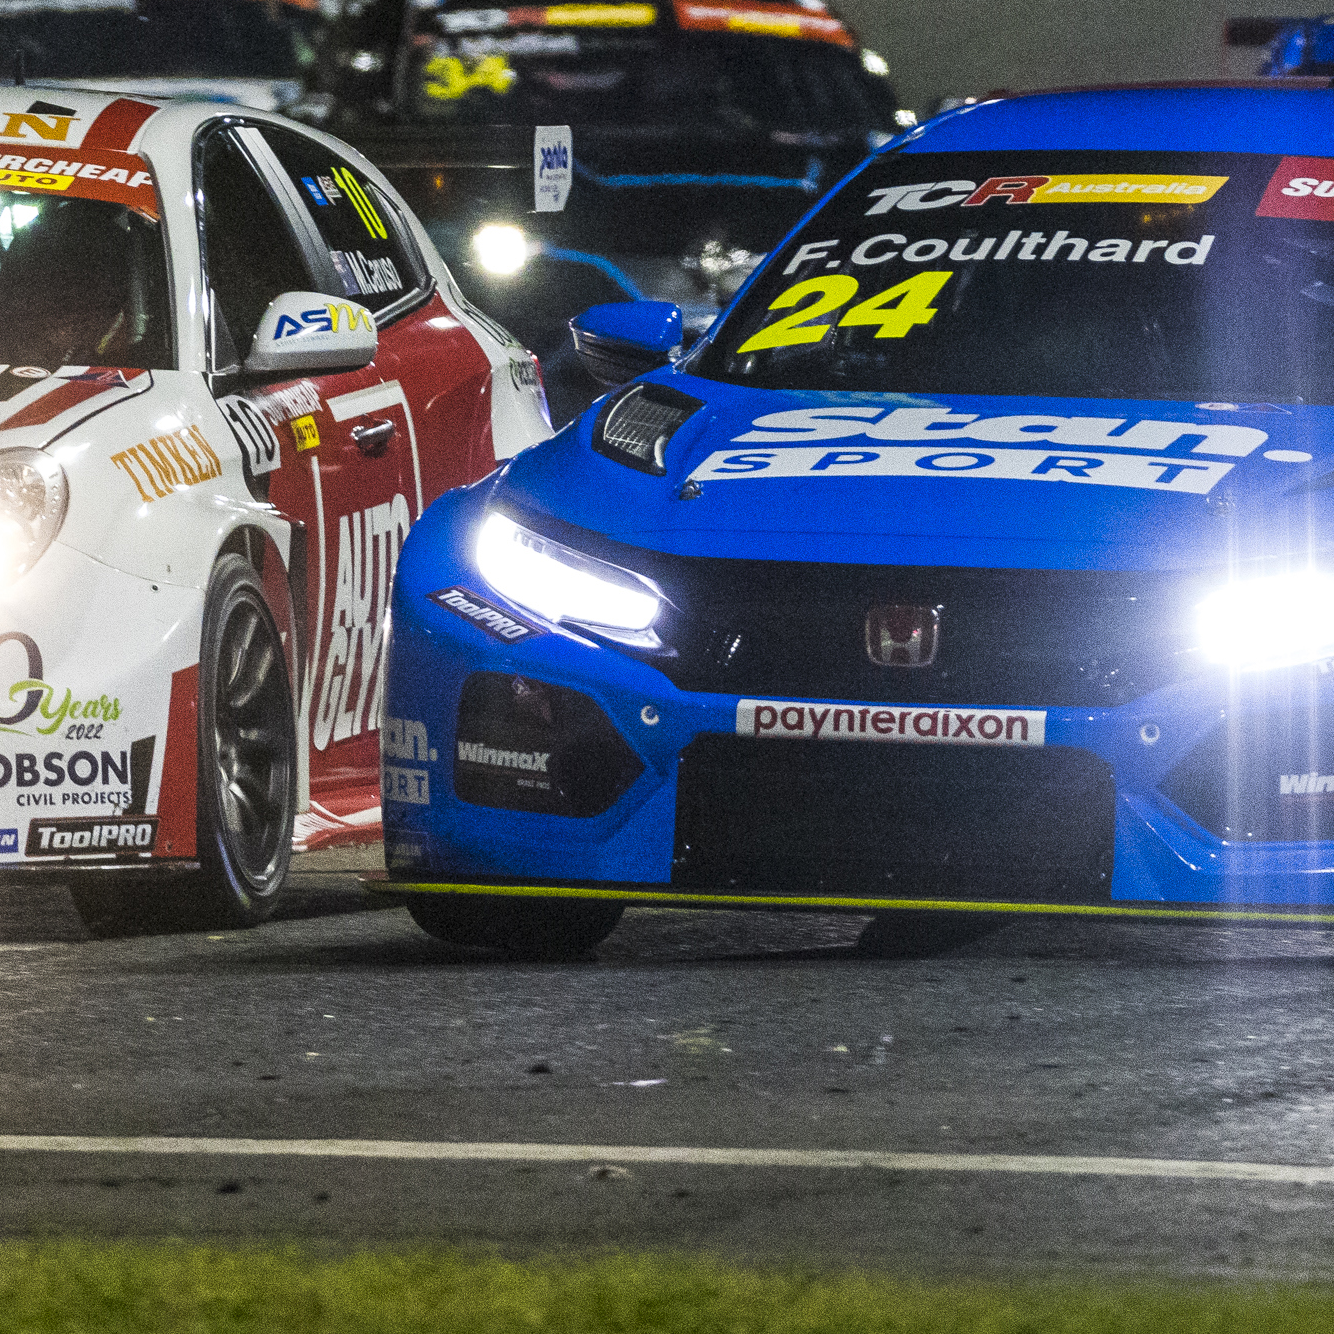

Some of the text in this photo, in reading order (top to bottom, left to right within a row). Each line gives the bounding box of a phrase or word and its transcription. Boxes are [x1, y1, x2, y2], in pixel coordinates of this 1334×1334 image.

[424, 54, 514, 100] 34
[330, 166, 388, 239] 10
[864, 174, 1208, 216] TCR Australia
[782, 230, 1216, 276] F.Coulthard
[736, 271, 954, 354] 24
[225, 400, 276, 463] 10
[296, 423, 317, 442] AUTO
[110, 423, 223, 503] TIMKEN
[710, 451, 1216, 484] SPORT
[437, 589, 530, 640] ToolPRO
[9, 678, 123, 735] Years
[753, 703, 1029, 743] paynterdixon
[66, 723, 104, 740] 2022
[16, 791, 131, 807] CIVIL PROJECTS
[38, 823, 152, 850] ToolPRO
